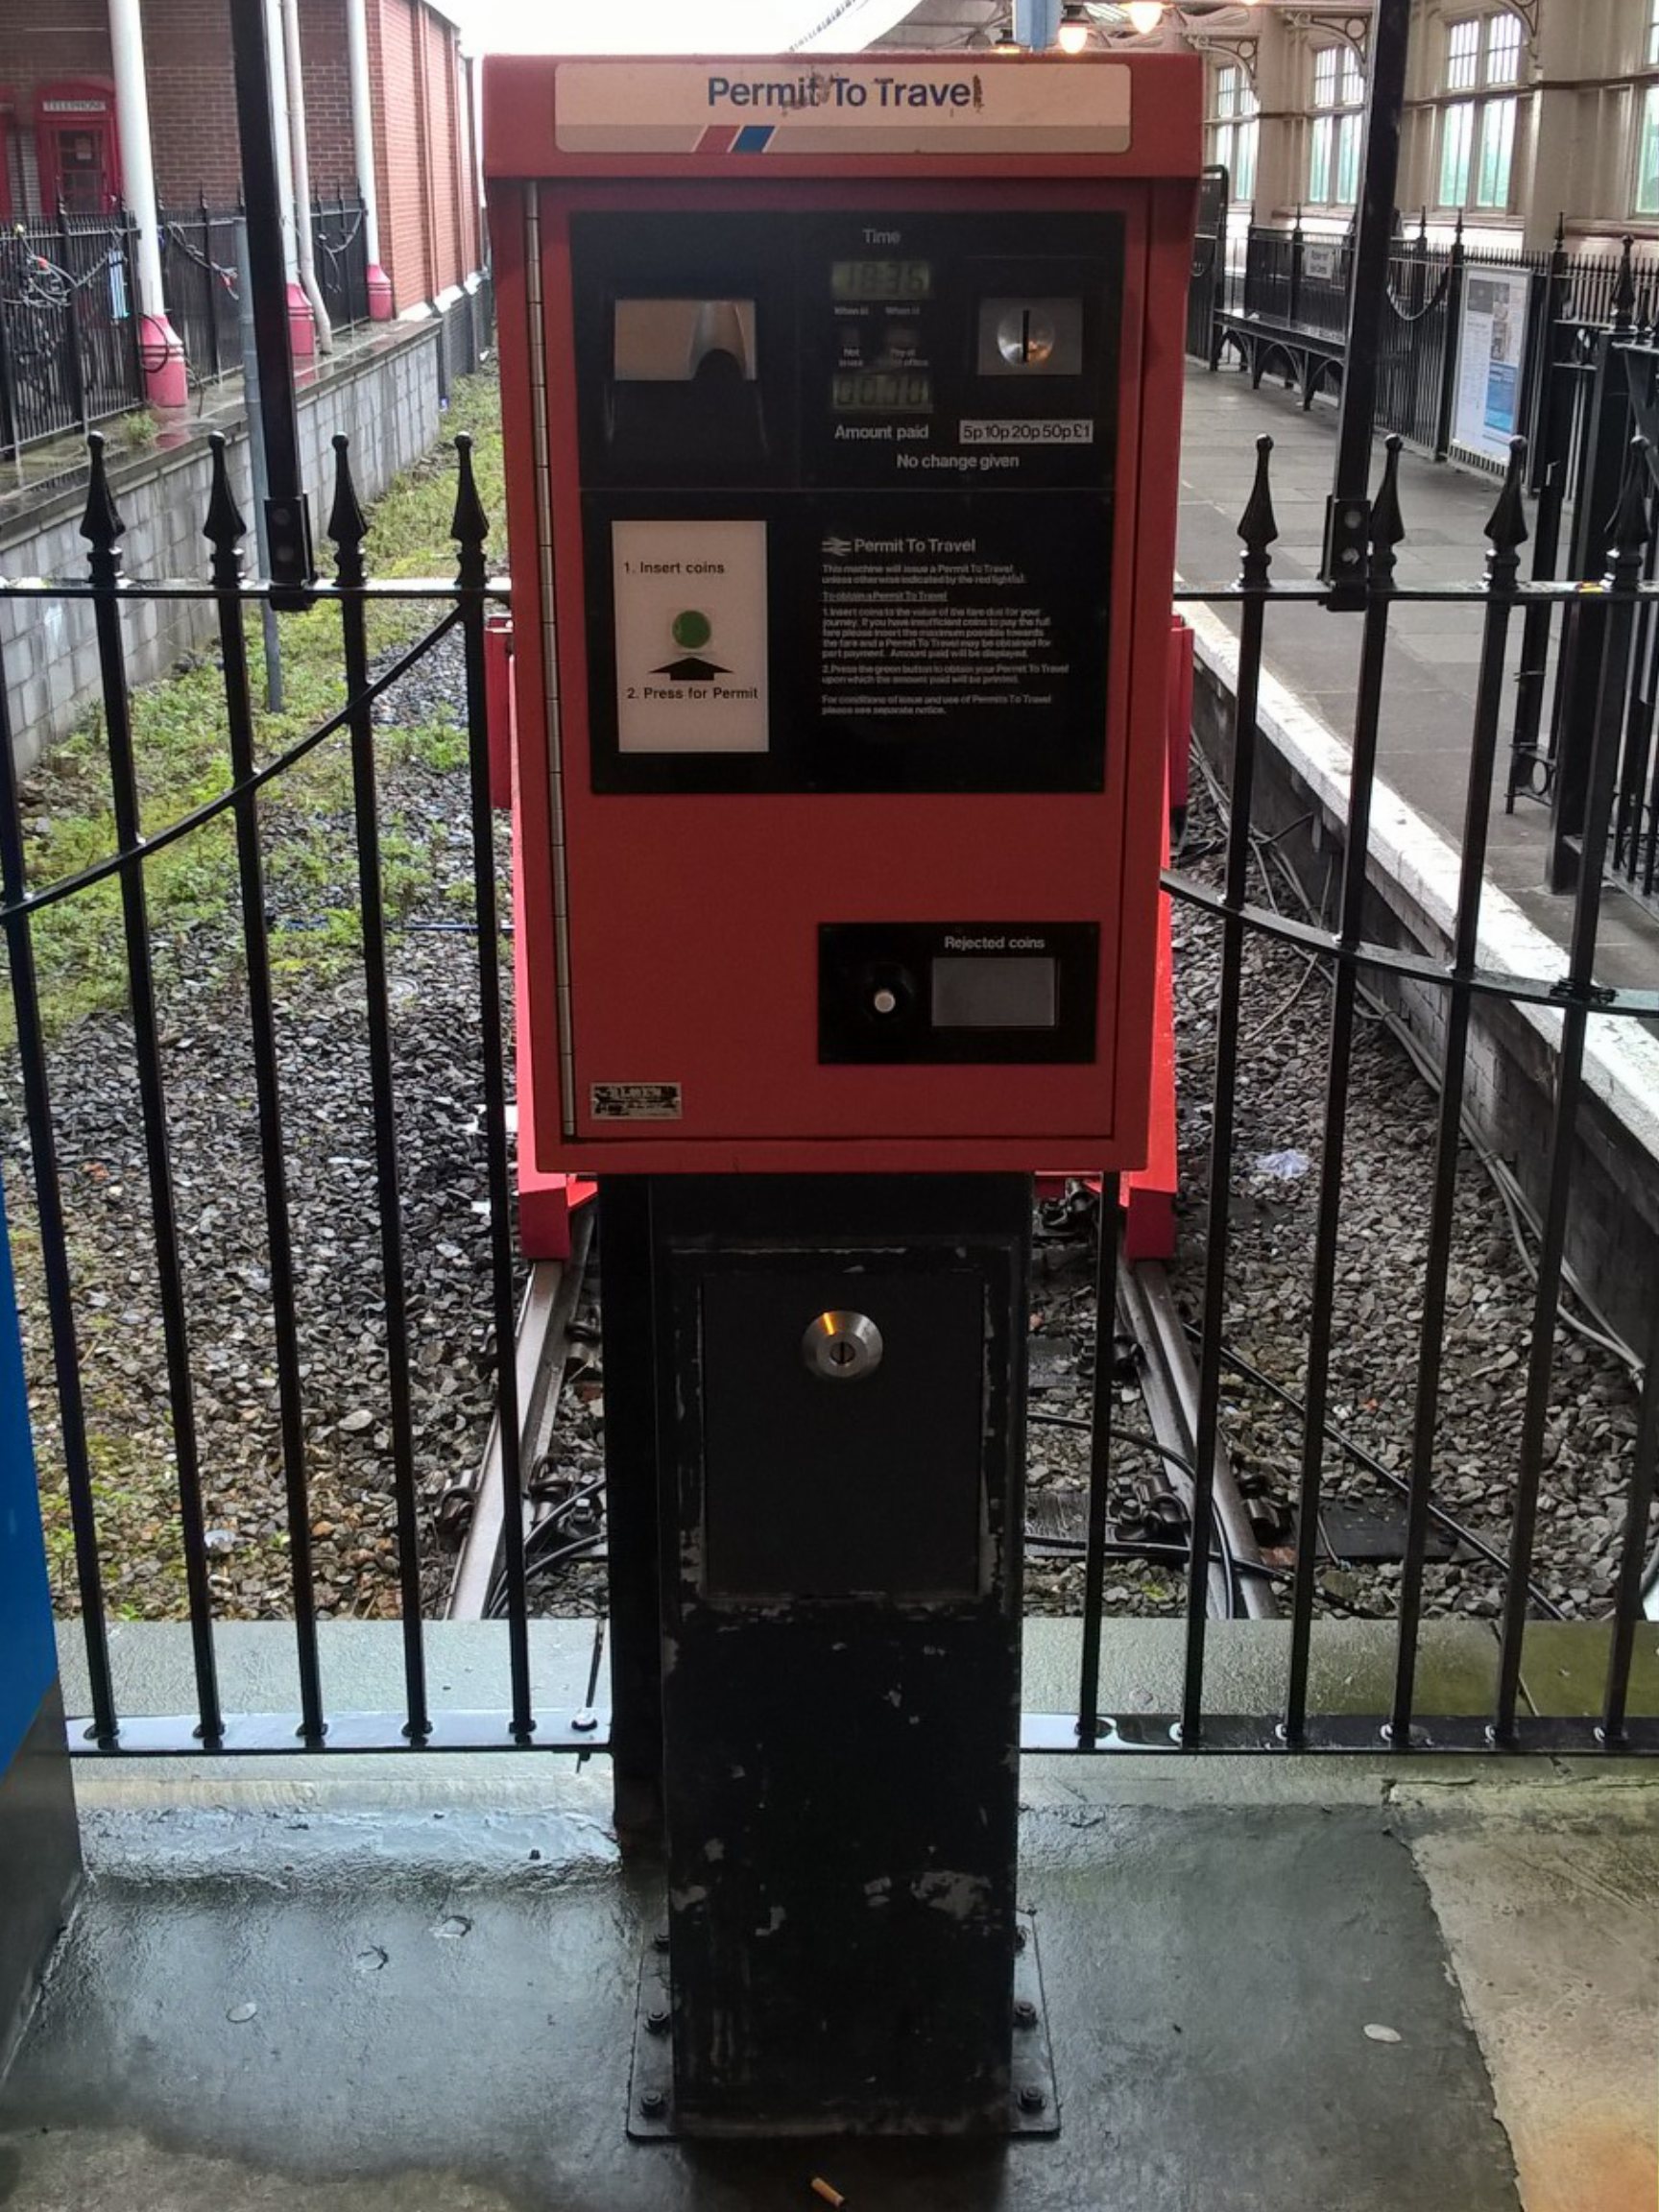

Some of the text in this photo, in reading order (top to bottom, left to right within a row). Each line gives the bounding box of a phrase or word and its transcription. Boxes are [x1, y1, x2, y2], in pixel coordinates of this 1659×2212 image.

[708, 77, 983, 108] Permit To Travel
[862, 228, 901, 245] Time
[834, 424, 928, 441] Amount paid
[964, 424, 1090, 441] 5p 10p 20p 50p £1
[897, 453, 1020, 470] No change given
[854, 538, 976, 553] Permit To Travel
[624, 562, 725, 574] 1. Insert coins
[822, 565, 842, 574] This
[844, 565, 883, 574] machine
[885, 565, 901, 574] will
[903, 565, 928, 574] issue
[937, 565, 969, 574] Permit
[971, 565, 982, 574] To
[983, 565, 1013, 574] Travel
[627, 687, 758, 700] 2. Press for Permit
[944, 935, 1046, 950] Rejected coins
